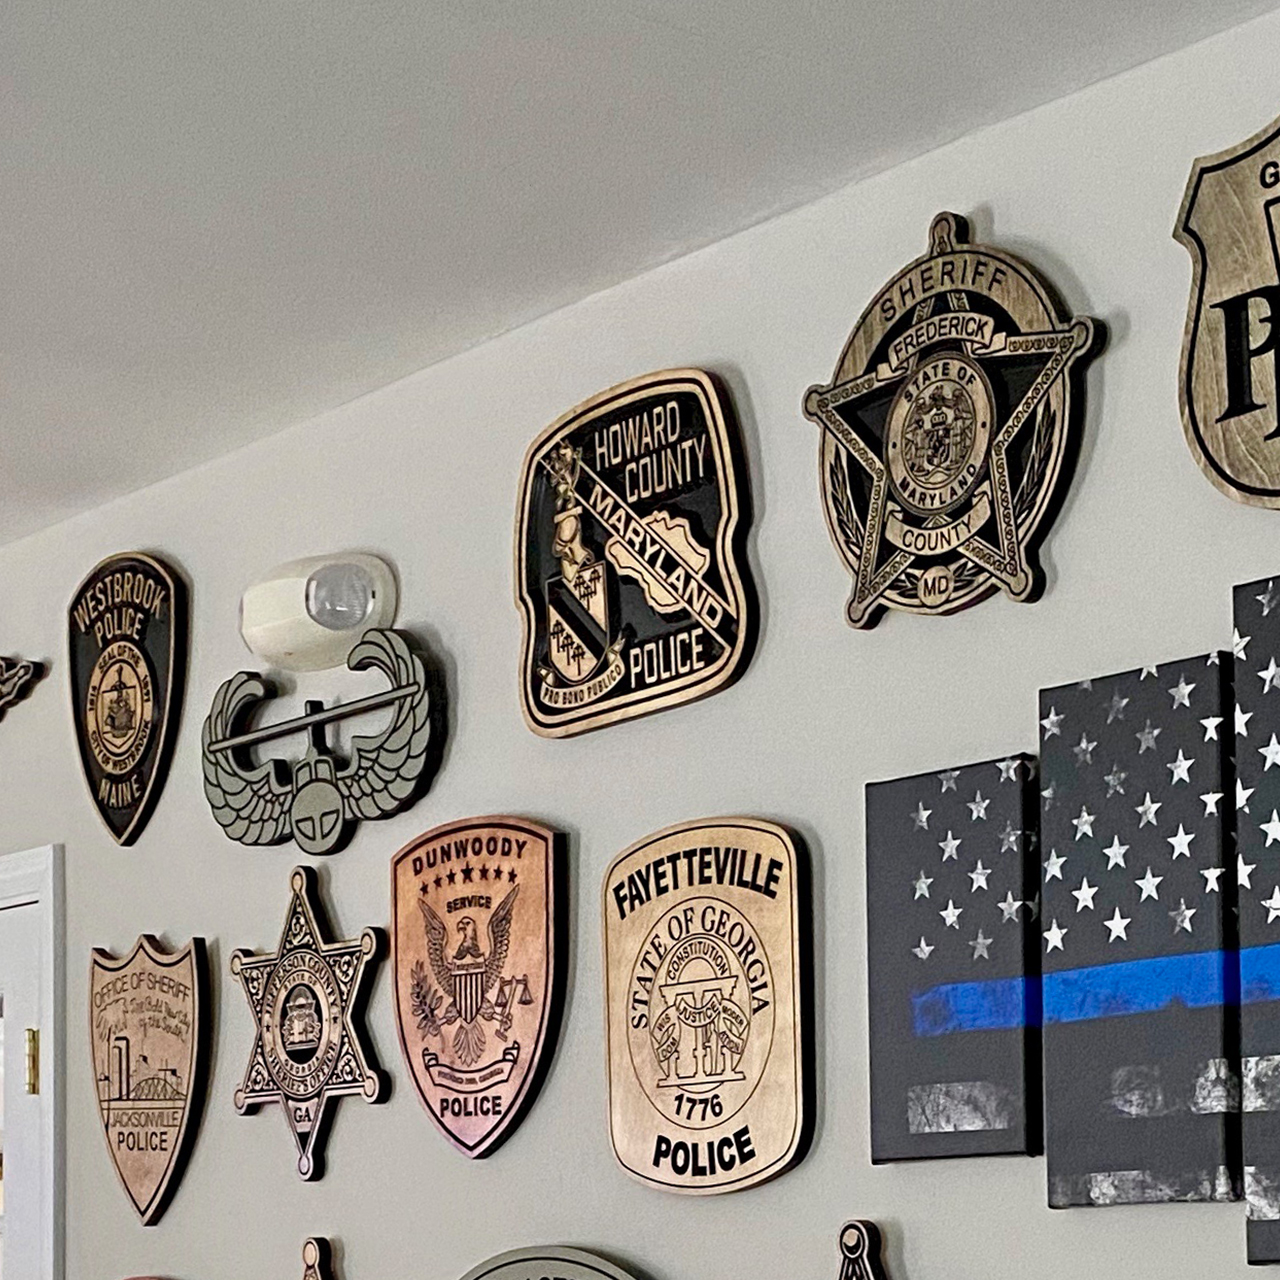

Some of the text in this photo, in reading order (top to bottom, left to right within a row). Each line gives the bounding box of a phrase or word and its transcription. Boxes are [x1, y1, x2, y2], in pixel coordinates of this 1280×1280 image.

[880, 260, 1008, 323] SHERIFF
[893, 315, 990, 362] FREDERICK
[904, 361, 978, 403] STATE OF
[593, 401, 680, 472] HOWARD
[625, 434, 709, 504] COUNTY
[898, 463, 979, 507] MARYLAND
[901, 515, 976, 551] COUNTY
[588, 483, 723, 630] MARYLAND
[74, 571, 166, 633] WESTBROOK
[923, 574, 949, 596] MD
[94, 607, 144, 648] POLICE
[629, 627, 705, 690] POLICE
[543, 687, 560, 705] PRO
[587, 664, 623, 699] PUBLICO
[98, 773, 142, 808] MAINE
[412, 836, 528, 876] DUNWOODY
[612, 846, 783, 920] FAYETTEVILLE
[308, 956, 340, 1005] COUNTY
[631, 905, 770, 1030] STATE OF GEORGIA
[668, 941, 728, 981] CONSTITUTION
[94, 972, 191, 1008] OFFICE OF SHERIFF
[679, 1000, 719, 1023] JUSTICE
[110, 1111, 179, 1128] JACKSONVILLE
[293, 1106, 312, 1124] GA
[440, 1096, 502, 1118] POLICE
[674, 1093, 723, 1121] 1776
[117, 1131, 168, 1151] POLICE
[652, 1125, 757, 1178] POLICE
